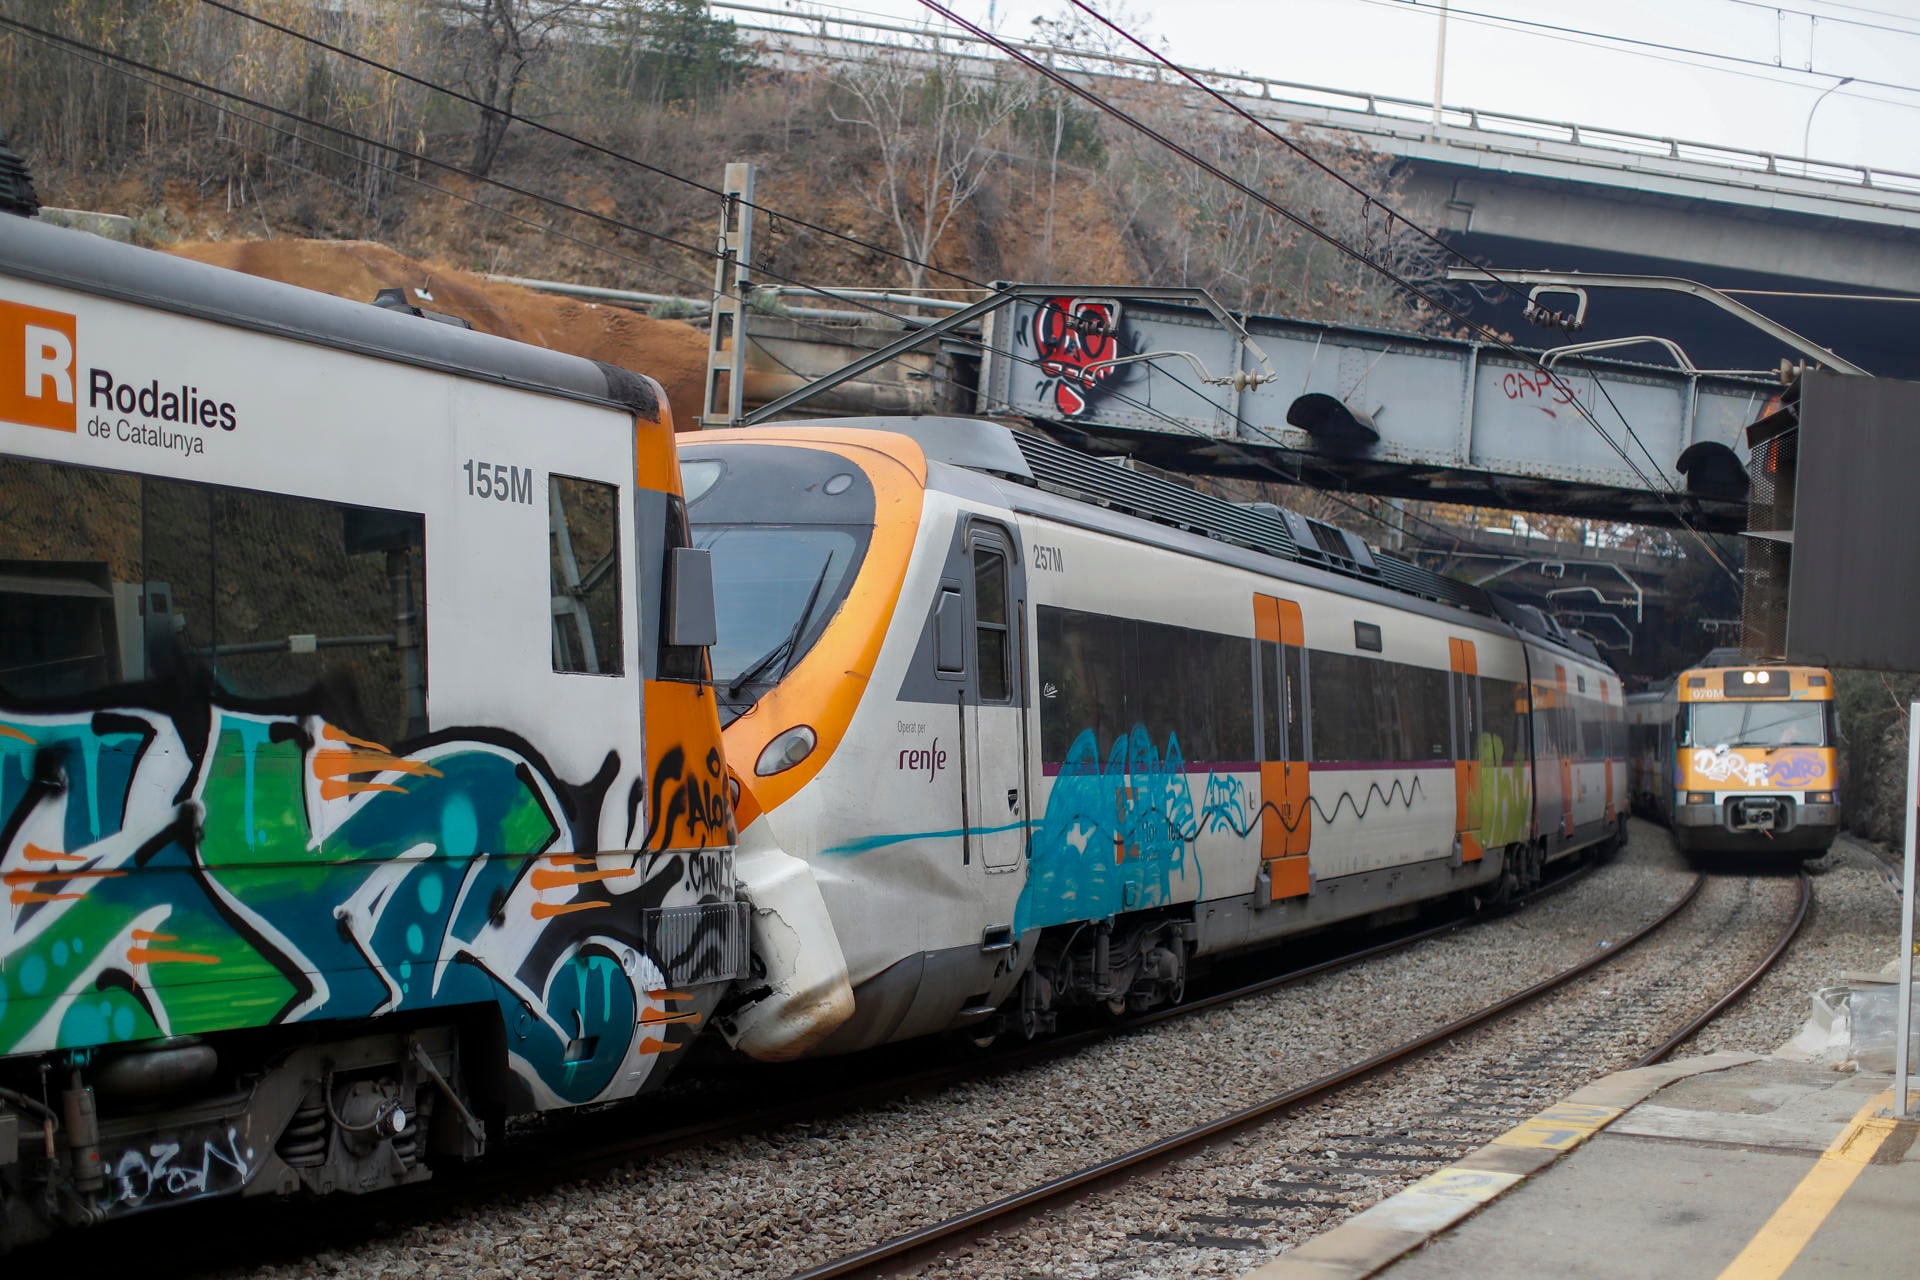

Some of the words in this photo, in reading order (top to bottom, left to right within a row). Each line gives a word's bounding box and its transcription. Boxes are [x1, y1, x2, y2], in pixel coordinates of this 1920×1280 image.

[24, 323, 74, 404] R
[89, 367, 237, 432] Rodalies
[87, 415, 111, 438] de
[116, 418, 205, 457] Catalunya
[463, 458, 533, 505] 155M
[1033, 544, 1064, 573] 257M
[897, 720, 917, 735] Operat
[917, 722, 927, 737] per
[899, 737, 947, 783] renfe
